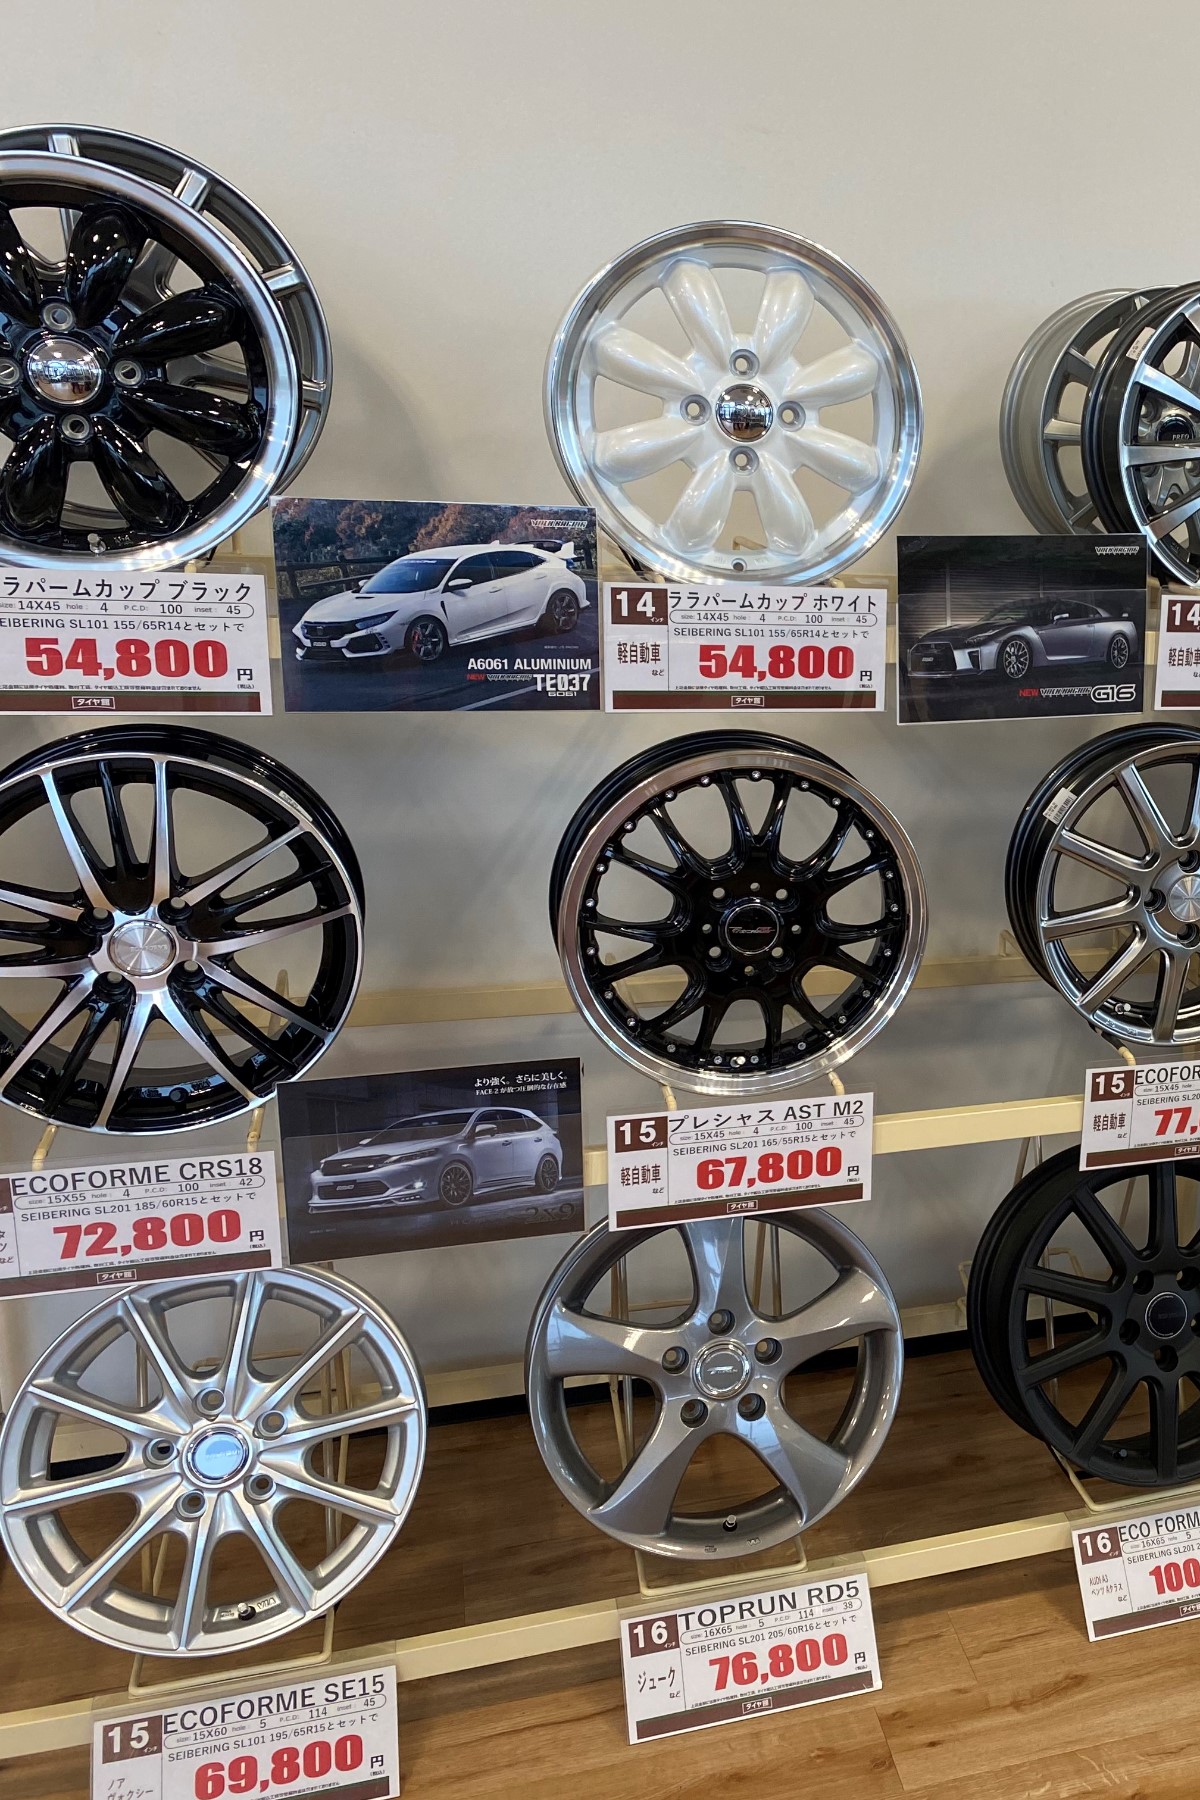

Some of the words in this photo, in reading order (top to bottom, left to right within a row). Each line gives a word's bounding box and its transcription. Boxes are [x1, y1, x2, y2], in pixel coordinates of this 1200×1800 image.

[168, 582, 251, 601] ブラック
[669, 591, 808, 610] ララパームカップ
[813, 595, 876, 612] ホワイト
[70, 619, 109, 629] SL101
[697, 613, 729, 621] 14X45
[805, 615, 823, 624] 100
[856, 616, 867, 624] 45
[674, 627, 731, 637] SEIBERING
[734, 628, 765, 637] SL101
[25, 637, 228, 680] 54,800
[468, 658, 508, 670] A6061
[514, 658, 591, 670] ALUMINIUM
[617, 642, 661, 664] 軽自動車
[699, 645, 854, 682] 54,800
[1168, 648, 1200, 667] 軽自動車
[1155, 1084, 1179, 1092] 15X45
[1137, 1095, 1180, 1106] SEIBERING
[669, 1109, 775, 1133] プレシャス
[784, 1103, 826, 1121] AST
[833, 1100, 863, 1115] M2
[1093, 1113, 1126, 1132] 軽自動車
[695, 1130, 725, 1140] 15X45
[795, 1122, 813, 1131] 100
[673, 1144, 727, 1156] SEIBERING
[730, 1140, 758, 1150] SL201
[12, 1165, 170, 1196] ECOFORME
[179, 1158, 262, 1181] CRS18
[621, 1164, 661, 1186] 軽自動車
[696, 1146, 842, 1190] 67,800
[21, 1207, 90, 1222] SEIBERING
[94, 1202, 131, 1215] SL201
[53, 1209, 241, 1260] 72,800
[1119, 1522, 1150, 1542] ECO
[1127, 1548, 1172, 1564] SEIBERLING
[1174, 1542, 1195, 1555] SL201
[678, 1592, 797, 1631] TOPRUN
[808, 1580, 859, 1606] RD5
[704, 1625, 732, 1638] 16X65
[798, 1609, 814, 1620] 114
[843, 1601, 853, 1610] 38
[686, 1640, 736, 1656] SEIBERING
[739, 1634, 766, 1645] SL201
[709, 1633, 848, 1691] 76,800
[637, 1666, 676, 1693] ジューク
[164, 1687, 315, 1734] ECOFORME
[324, 1674, 385, 1703] SE15
[168, 1742, 230, 1762] SEIBERING
[233, 1735, 266, 1750] SL101
[194, 1734, 364, 1800] 69,800
